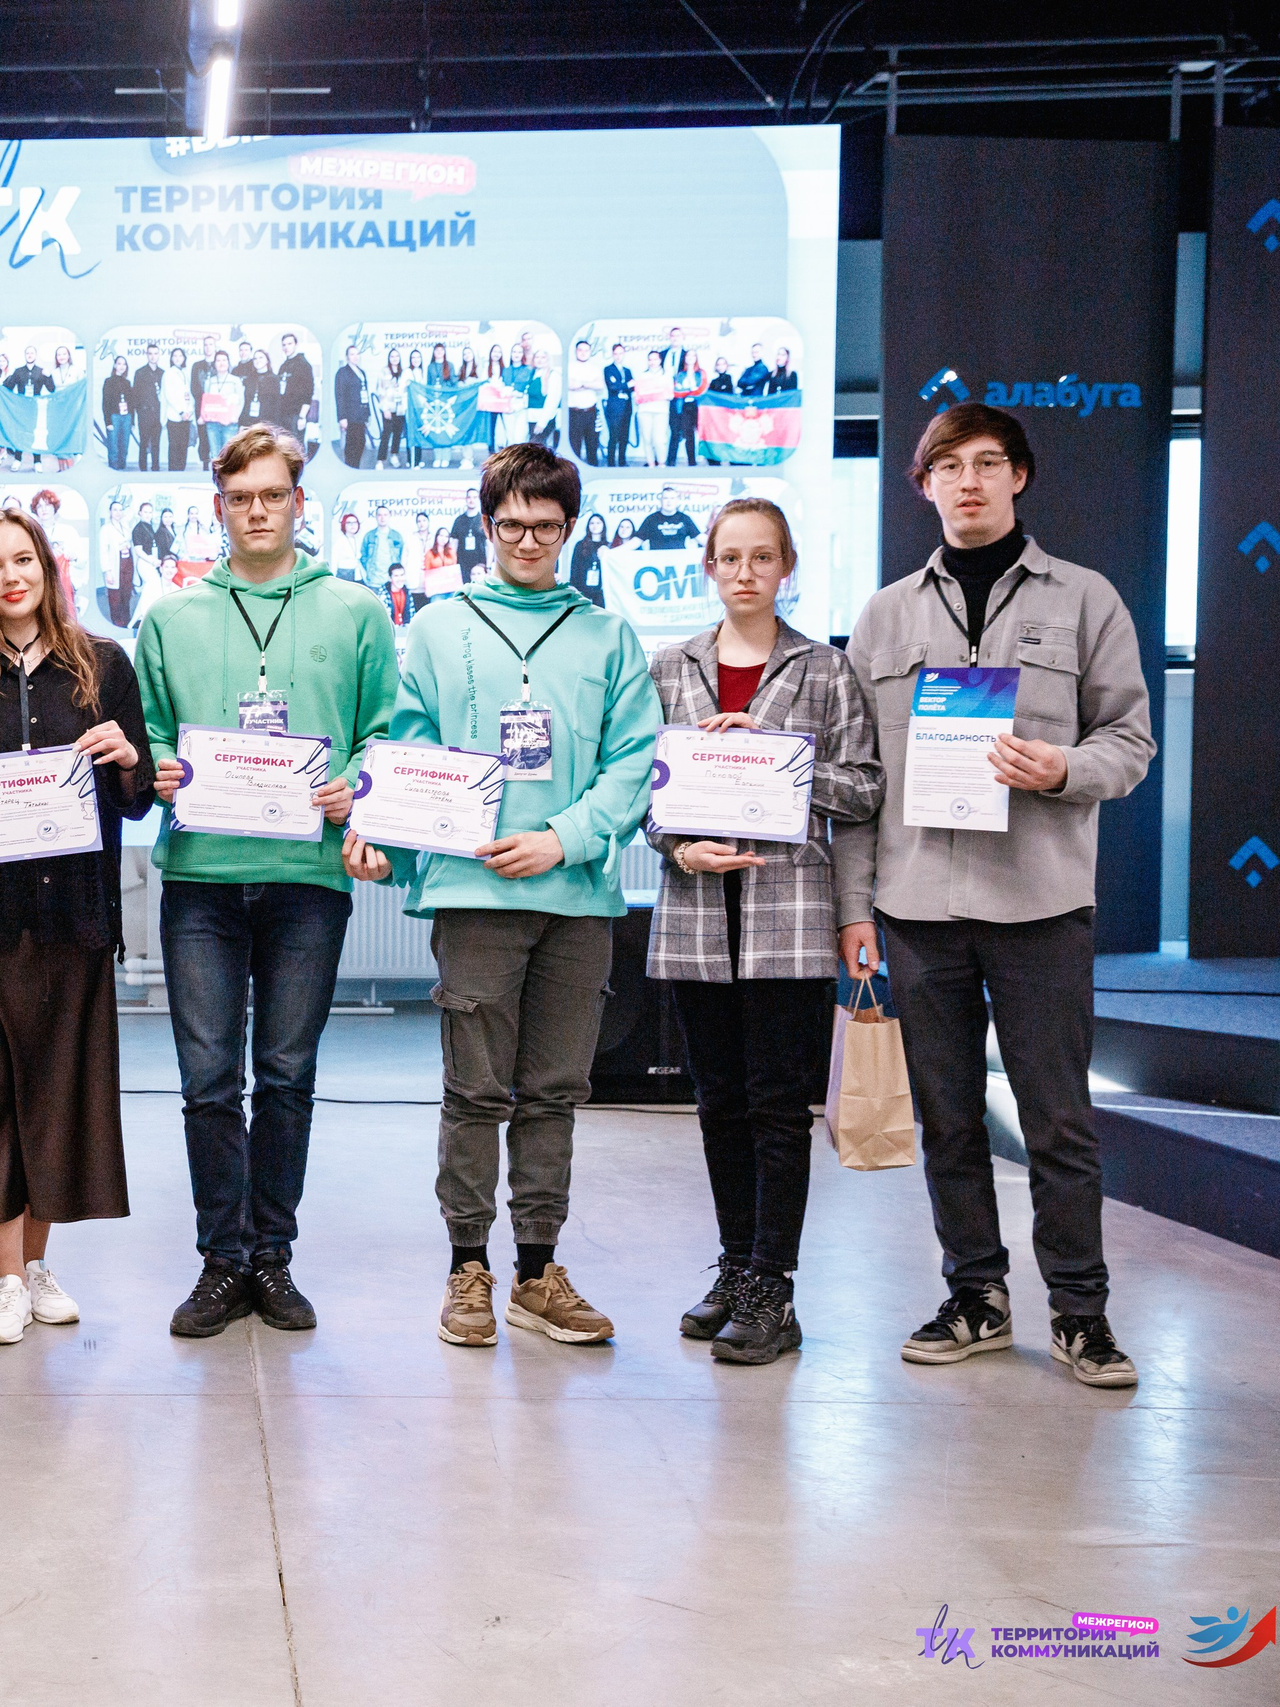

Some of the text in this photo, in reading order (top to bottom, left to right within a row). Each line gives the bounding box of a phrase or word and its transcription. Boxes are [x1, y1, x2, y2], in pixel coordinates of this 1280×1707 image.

[299, 156, 466, 186] МЕЖРЕГИОН
[115, 184, 383, 214] ТЕРРИТОРИЯ
[115, 211, 477, 253] КОММУНИКАЦИЙ
[983, 373, 1142, 418] алабуга
[461, 627, 480, 740] The frog kisses the princess
[915, 732, 997, 743] БЛАГОДАРНОСТЬ
[214, 753, 294, 768] СЕРТИФИКАТ
[692, 752, 776, 765] СЕРТИФИКАТ
[393, 766, 469, 783] СЕРТИФИКАТ
